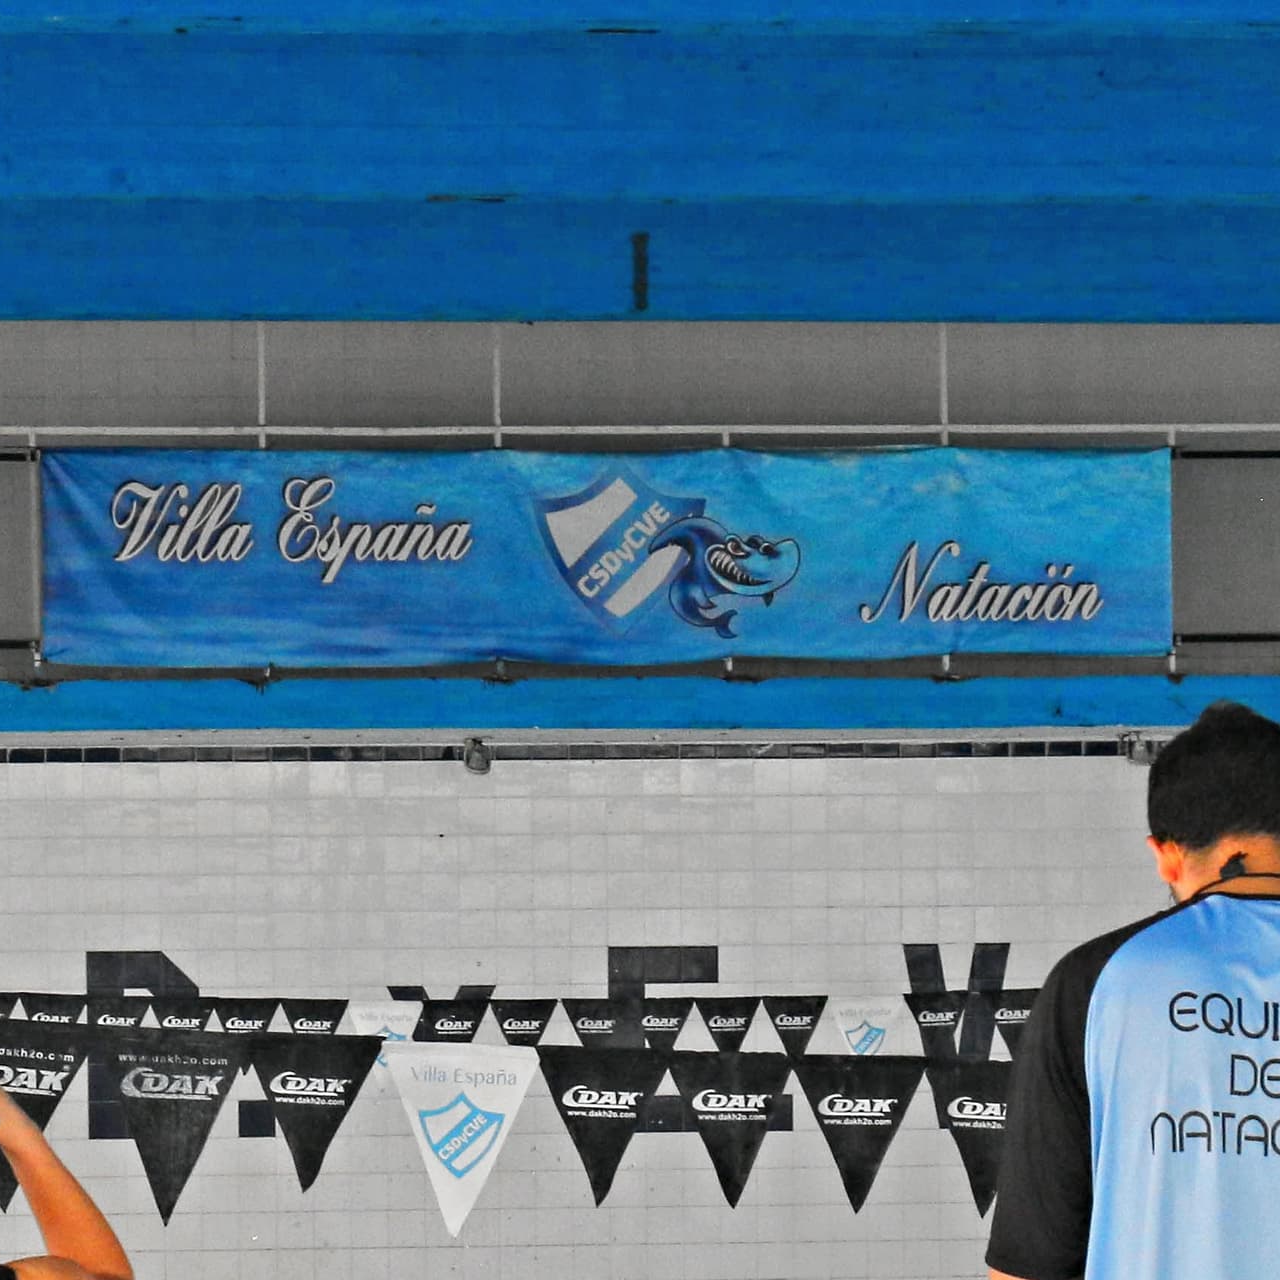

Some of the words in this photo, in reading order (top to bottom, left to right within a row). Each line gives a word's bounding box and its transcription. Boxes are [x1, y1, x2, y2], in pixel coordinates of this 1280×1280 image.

[111, 478, 255, 562] Villa
[277, 477, 473, 584] España
[576, 501, 670, 598] CSDyCVE
[860, 540, 1104, 622] Natación
[411, 1066, 447, 1083] Villa
[453, 1067, 517, 1087] España
